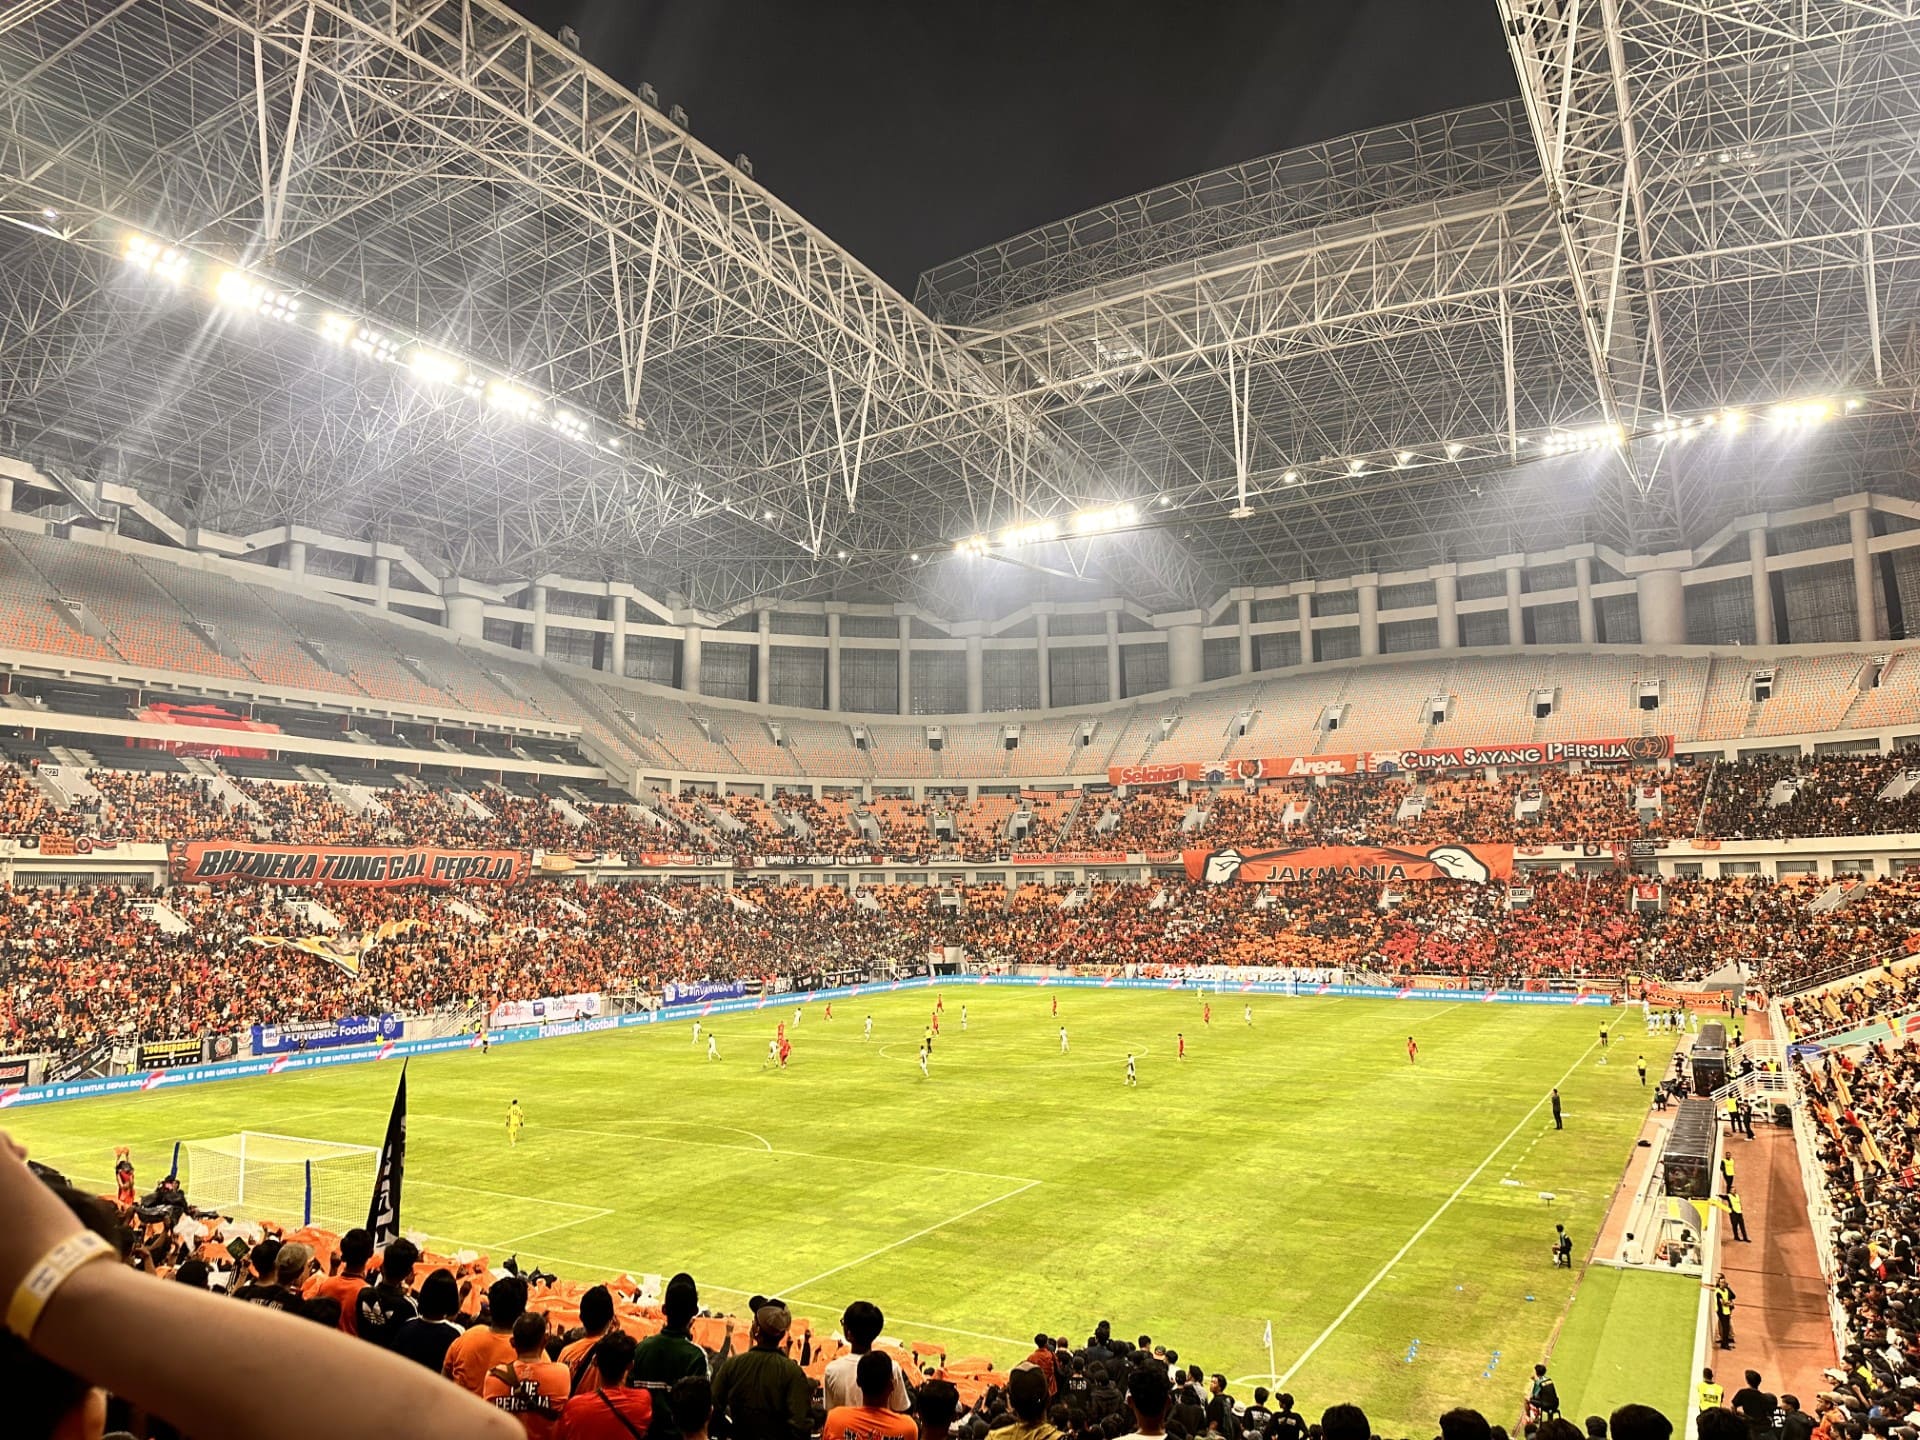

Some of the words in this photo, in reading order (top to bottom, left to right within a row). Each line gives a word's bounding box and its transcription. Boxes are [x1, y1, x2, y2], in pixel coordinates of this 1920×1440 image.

[1401, 751, 1460, 770] CUMA
[1463, 747, 1541, 766] SAYANG
[1546, 742, 1631, 761] PERSIJA
[1288, 757, 1346, 775] Area.
[1120, 767, 1185, 785] Selatan
[193, 849, 320, 880] BHINEKA
[318, 852, 428, 881] TUNGGAL
[430, 855, 514, 881] PERSIJA
[1266, 864, 1407, 882] JAKMANIA
[538, 1022, 583, 1038] FUNtastic
[584, 1017, 619, 1032] Football
[145, 1056, 198, 1068] PERSIJA
[80, 1083, 105, 1093] UNTUK
[106, 1080, 129, 1091] SEPAK
